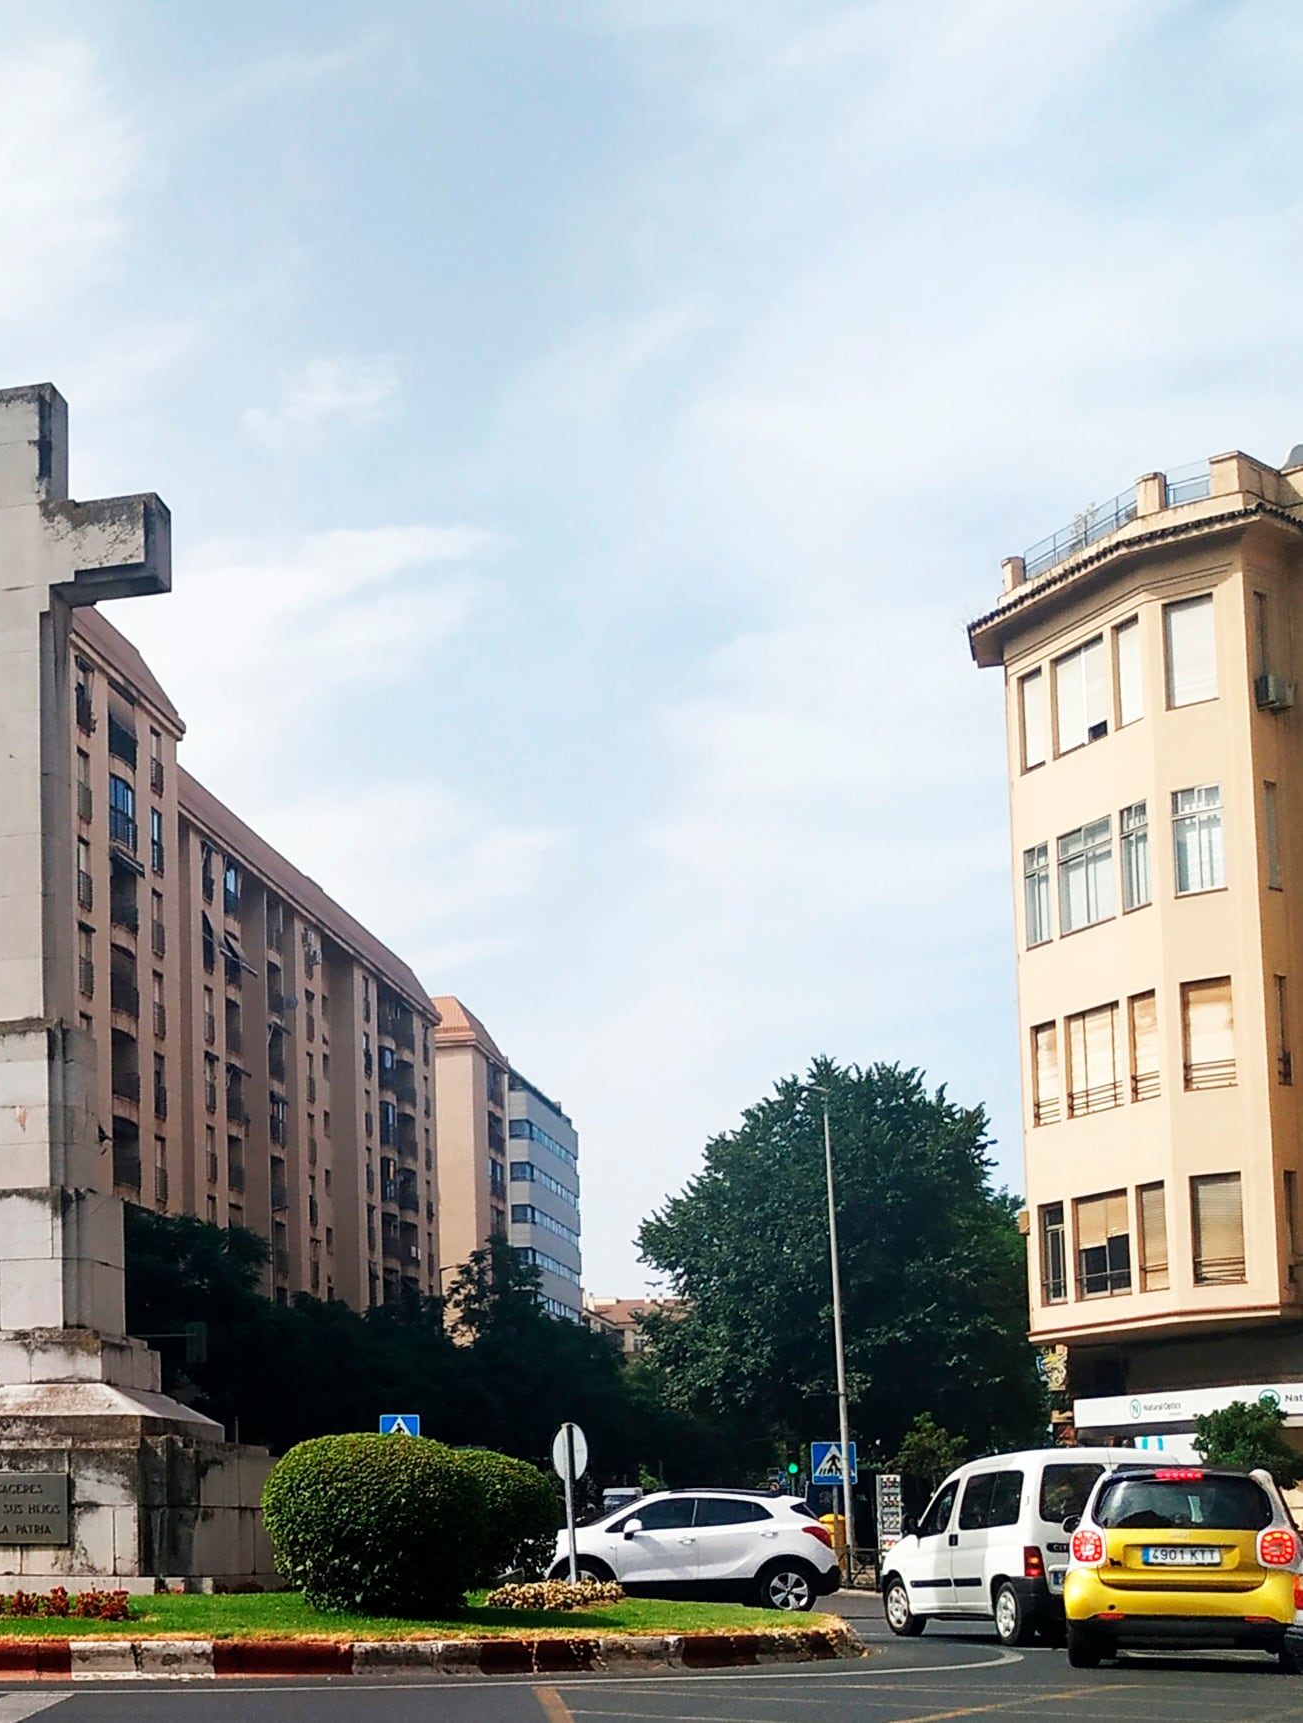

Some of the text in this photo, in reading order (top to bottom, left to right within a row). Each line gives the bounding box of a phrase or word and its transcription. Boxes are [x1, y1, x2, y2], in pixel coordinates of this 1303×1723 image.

[1143, 1401, 1181, 1411] Natural Optics
[3, 1504, 23, 1515] SUS
[28, 1504, 61, 1516] HIJOS
[15, 1524, 52, 1535] PATRIA
[1151, 1549, 1216, 1561] 4901 KTT
